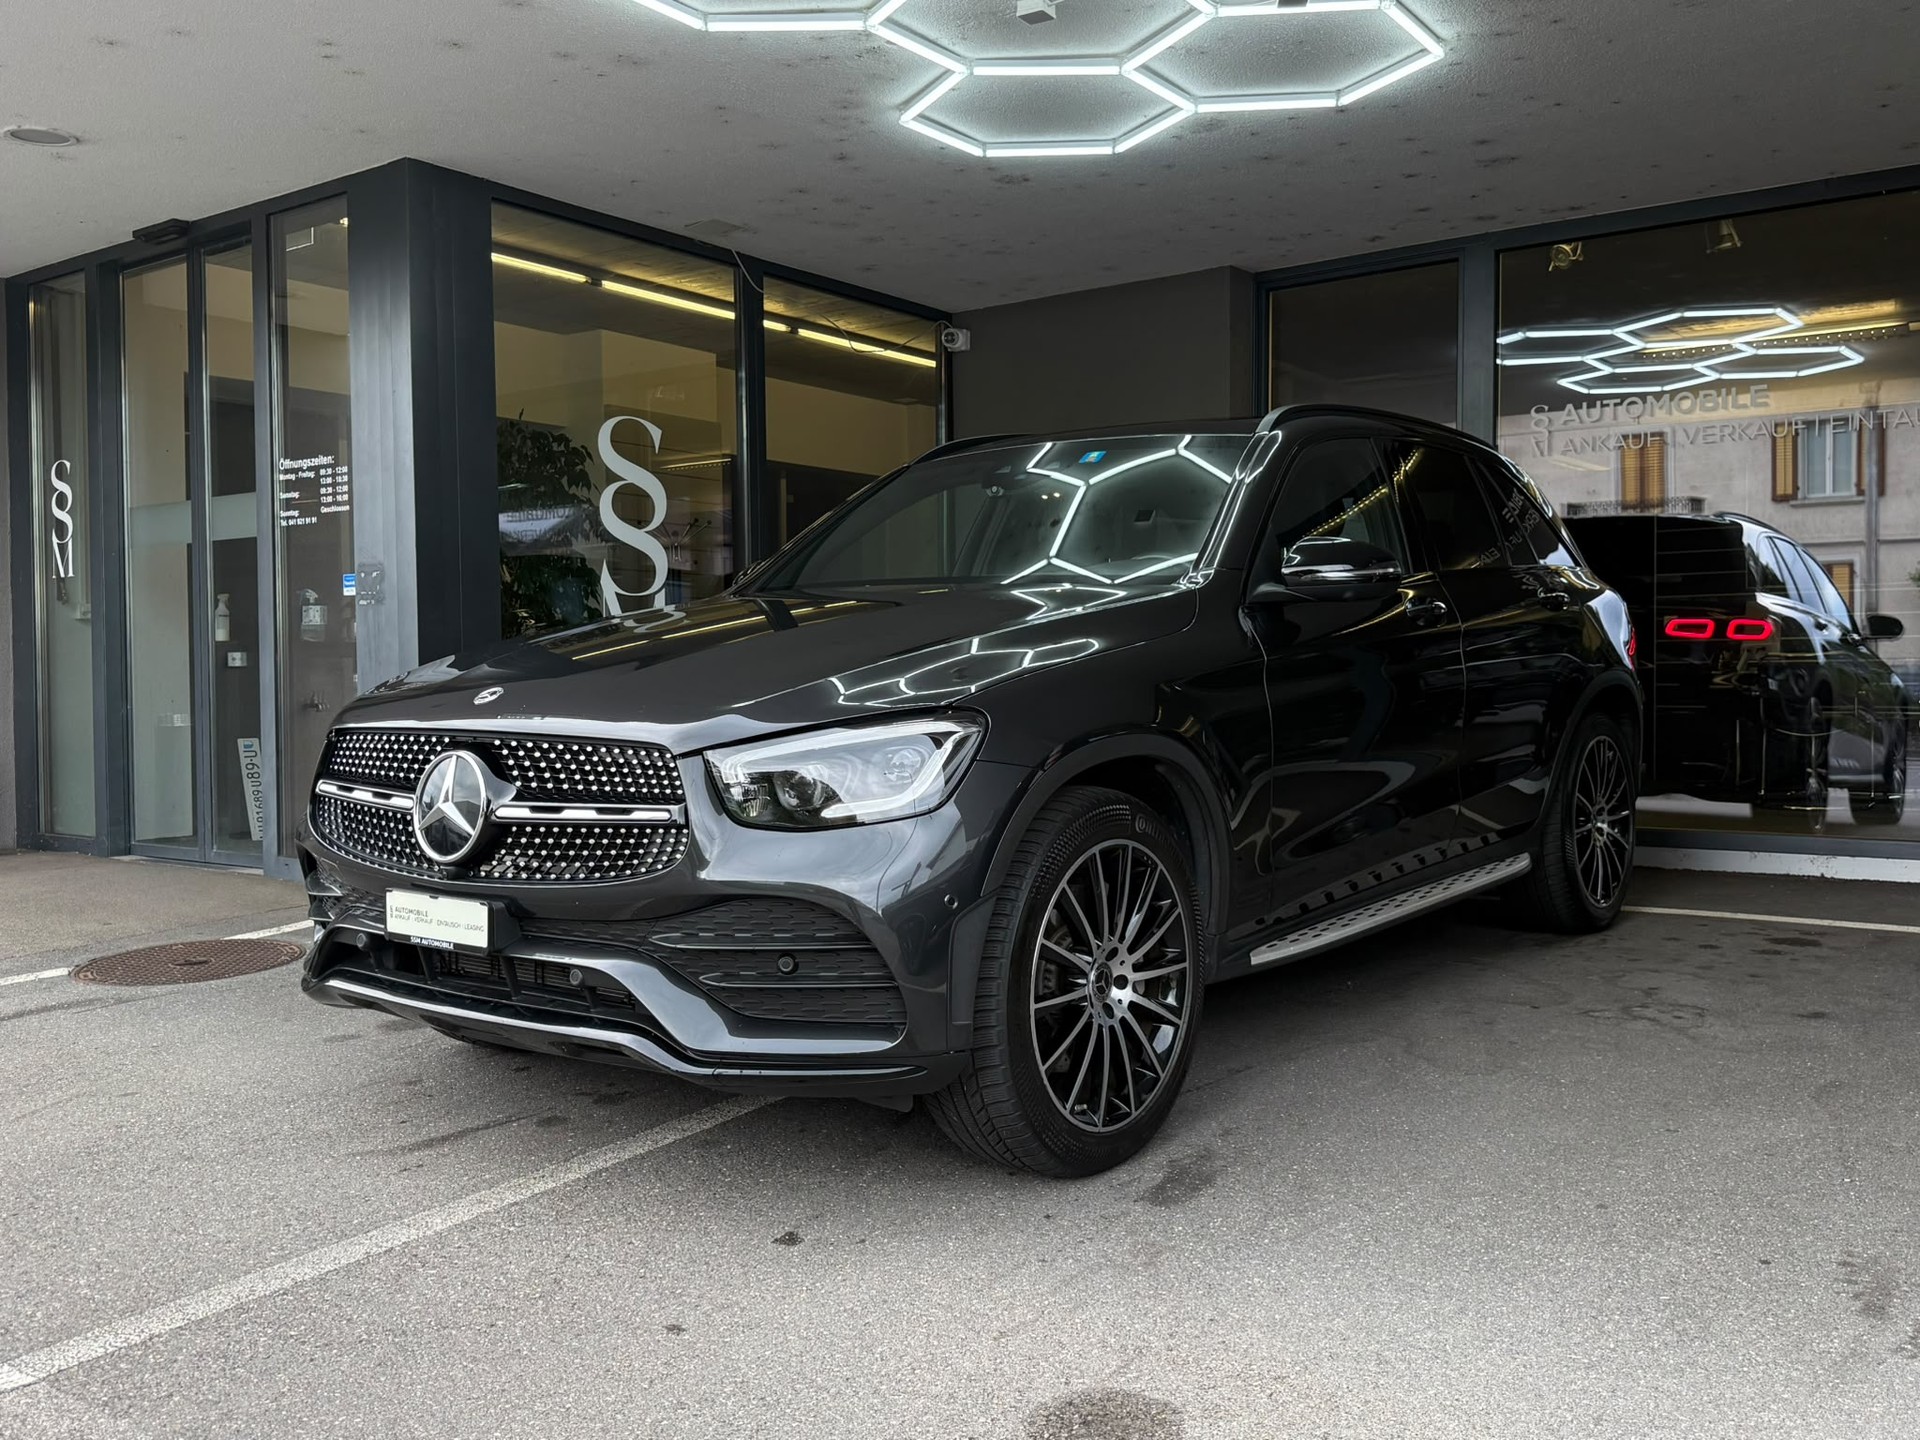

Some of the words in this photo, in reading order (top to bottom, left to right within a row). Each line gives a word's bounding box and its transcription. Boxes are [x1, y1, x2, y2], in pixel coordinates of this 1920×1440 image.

[1561, 384, 1770, 425] AUTOMOBILE
[1561, 430, 1661, 456] ANKAUF
[1682, 417, 1807, 445] VERKAUF
[1830, 407, 1920, 433] EINTA
[279, 455, 335, 470] Öffnungszeiten:
[320, 505, 350, 514] Geschlossen
[422, 938, 454, 950] AUTOMOBILE
